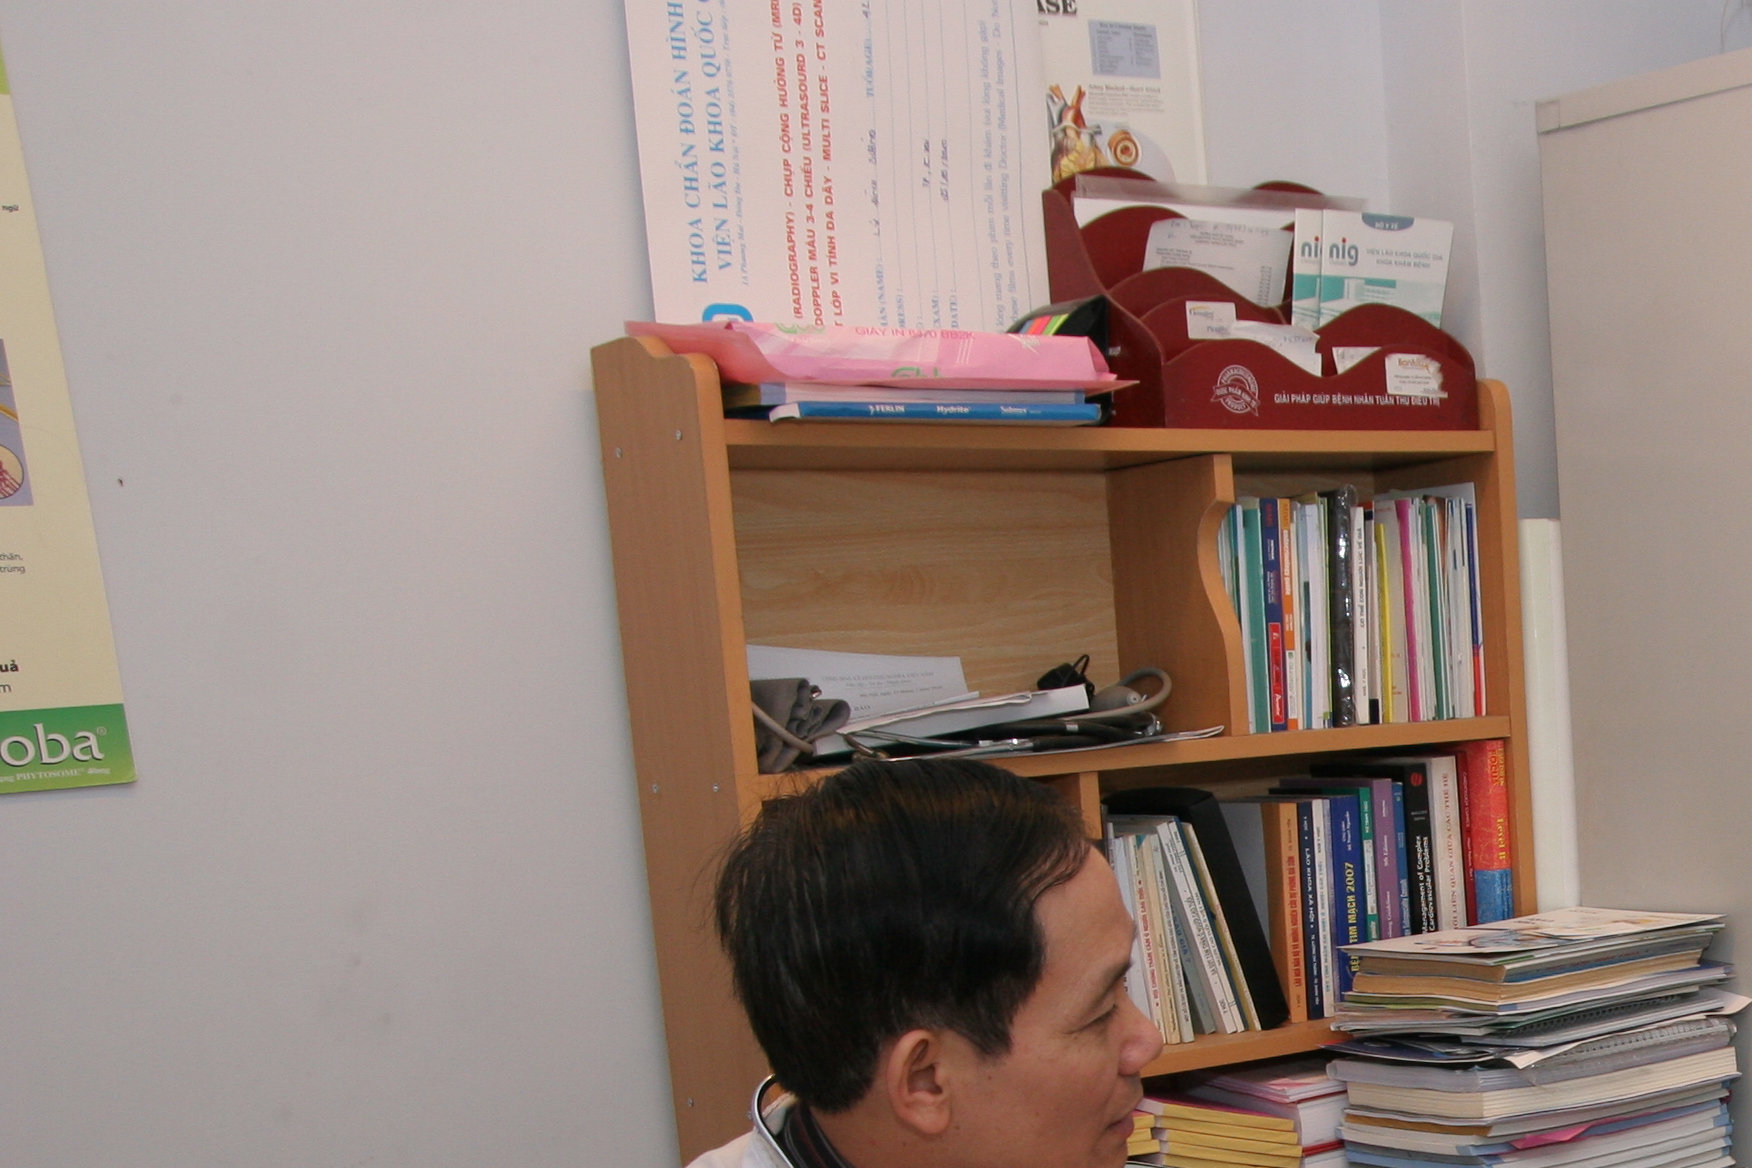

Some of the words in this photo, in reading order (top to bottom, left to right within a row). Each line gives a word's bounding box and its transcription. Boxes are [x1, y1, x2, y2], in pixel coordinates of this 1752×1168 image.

[790, 2, 804, 25] 4D)
[663, 0, 687, 61] HÌNH
[690, 12, 718, 78] QUỐC
[794, 39, 803, 48] 3
[815, 42, 826, 59] CT
[669, 69, 695, 135] ĐOÁN
[818, 76, 830, 111] SLICE
[703, 87, 724, 152] KHOA
[778, 113, 793, 152] CỘNG
[819, 118, 832, 160] MULTI
[995, 135, 1009, 168] Doctor
[673, 142, 701, 208] CHẨN
[706, 161, 728, 209] LÃO
[781, 158, 796, 196] CHỤP
[803, 204, 815, 222] 3-4
[687, 218, 707, 282] KHOA
[711, 218, 735, 269] VIỆN
[825, 236, 838, 267] TÍNH
[987, 247, 999, 267] theo
[1004, 241, 1016, 264] every
[1329, 237, 1359, 267] nig
[784, 211, 803, 318] (RADIOGRAPHY)
[829, 271, 840, 285] VI
[808, 266, 824, 325] DOPPLER
[829, 290, 842, 315] LỚP
[1494, 817, 1506, 847] Level
[1304, 848, 1312, 864] LÃO
[1413, 836, 1424, 868] Complex
[1420, 837, 1431, 871] Problems
[1497, 850, 1507, 860] B
[1305, 868, 1313, 890] KHOA
[1343, 862, 1355, 892] 2007
[1417, 871, 1424, 880] of
[1346, 895, 1358, 922] MẠCH
[1416, 883, 1430, 932] Management
[1424, 875, 1436, 929] Cardiovascular
[1347, 926, 1359, 941] TIM
